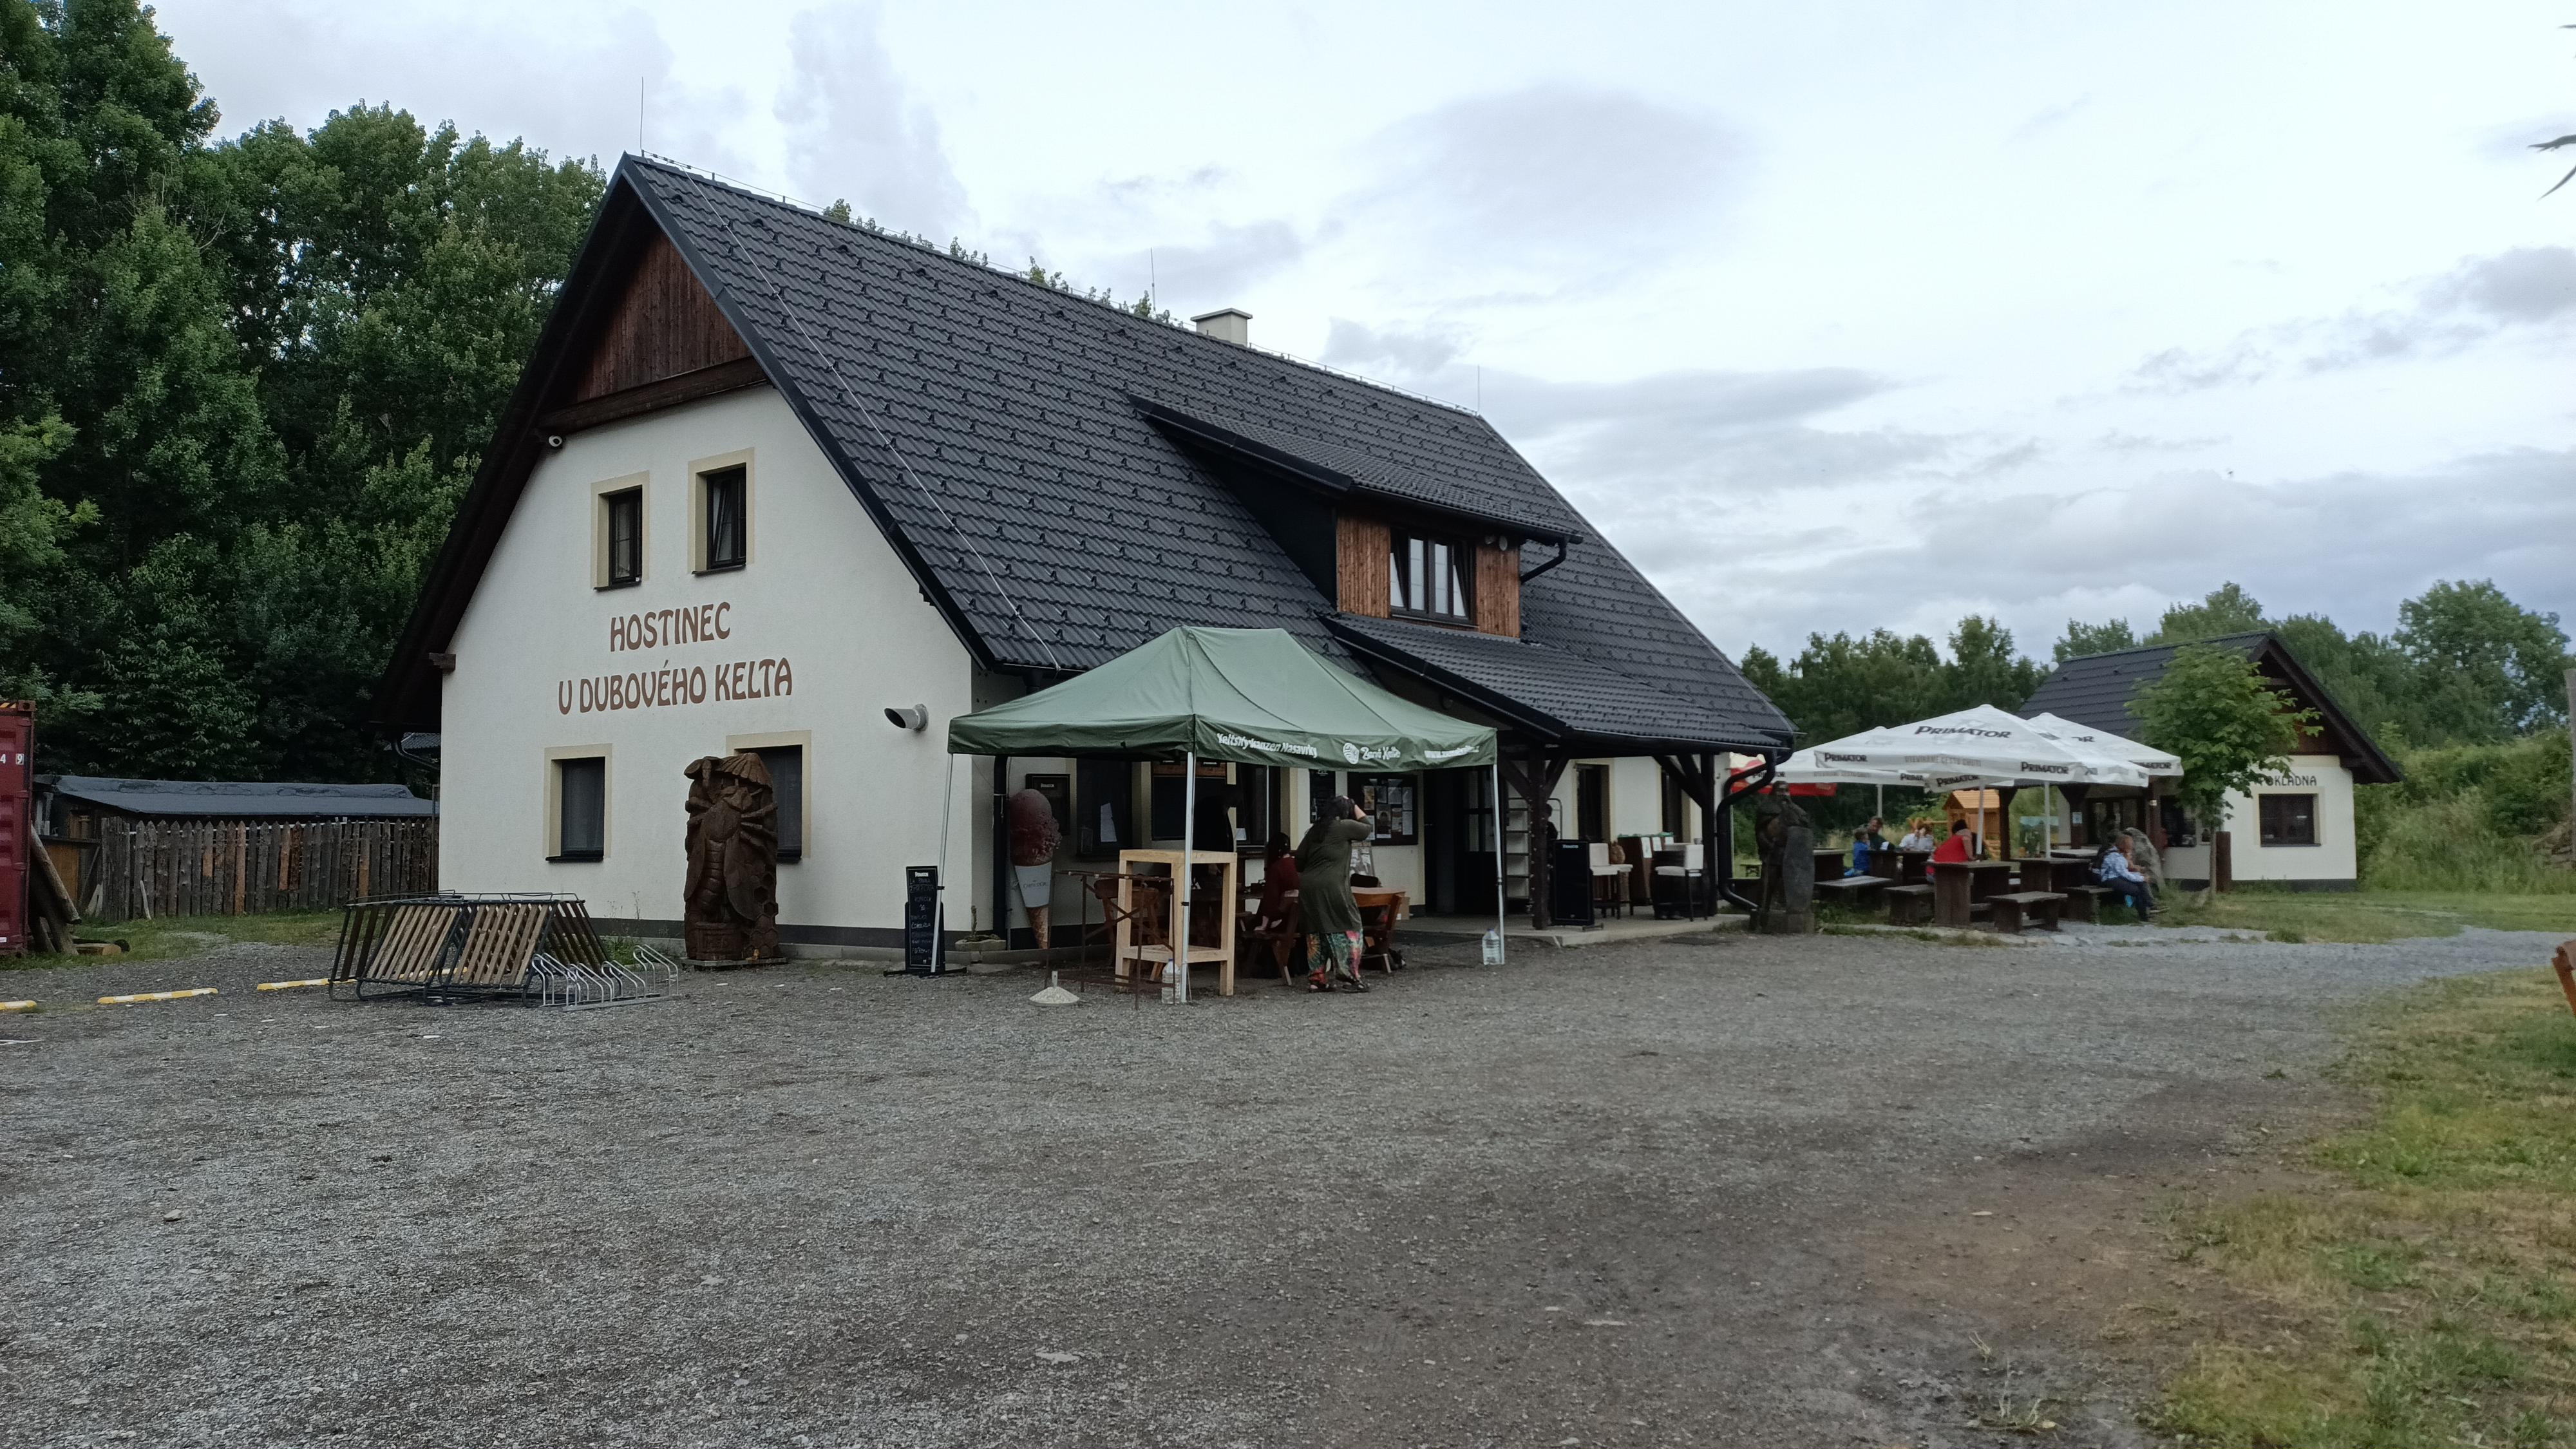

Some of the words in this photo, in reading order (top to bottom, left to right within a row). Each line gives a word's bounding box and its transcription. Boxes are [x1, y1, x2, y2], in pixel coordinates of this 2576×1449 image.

[610, 601, 731, 652] HOSTINEC
[558, 680, 573, 715] U
[580, 659, 706, 713] DUBOVÉHO
[715, 657, 793, 702] KELTA
[1914, 726, 2012, 739] PRIMATOR
[1824, 752, 1867, 762] PRIMATOR
[2020, 761, 2069, 774] PRIMATOR
[1937, 774, 1980, 787] PRIMATOR
